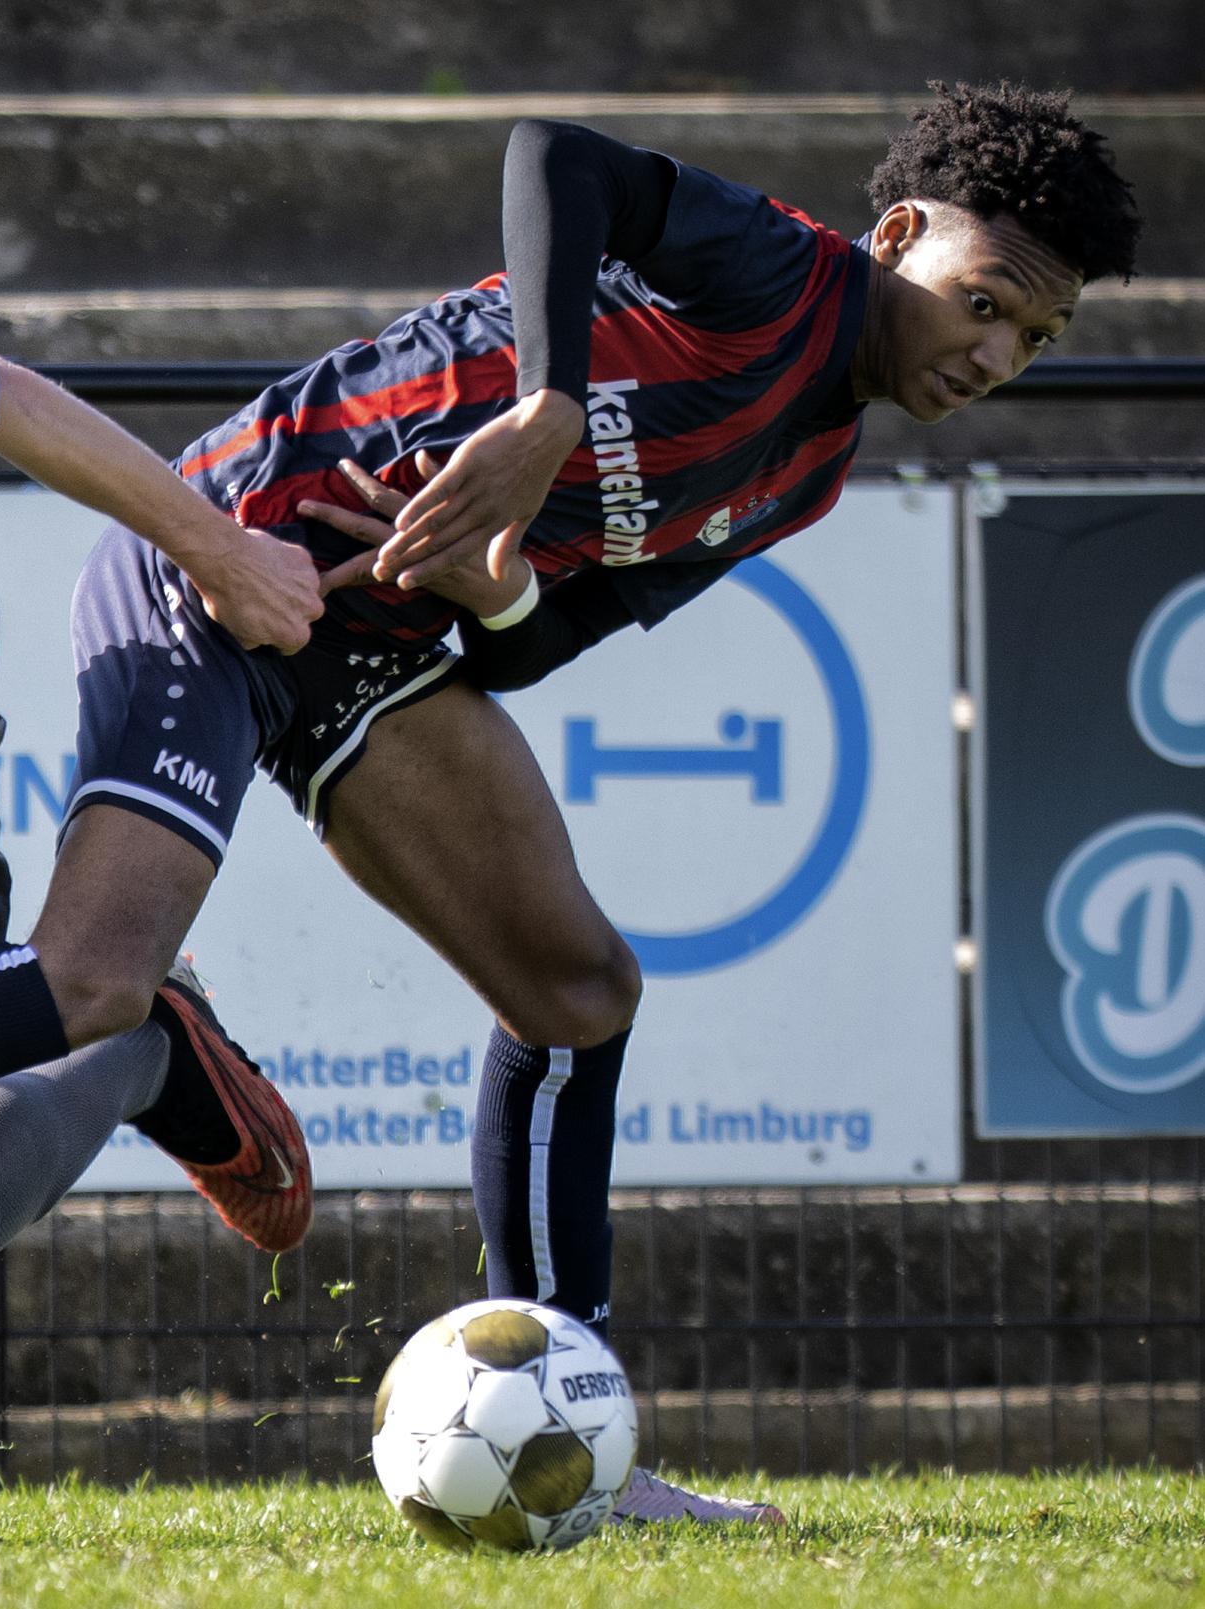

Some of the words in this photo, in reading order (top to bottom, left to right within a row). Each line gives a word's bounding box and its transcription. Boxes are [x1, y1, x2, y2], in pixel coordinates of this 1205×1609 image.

[587, 379, 659, 567] kamerland
[153, 748, 220, 808] KML
[257, 1045, 472, 1088] okterBed
[668, 1102, 872, 1152] Limburg
[560, 1371, 627, 1403] DERBYS
